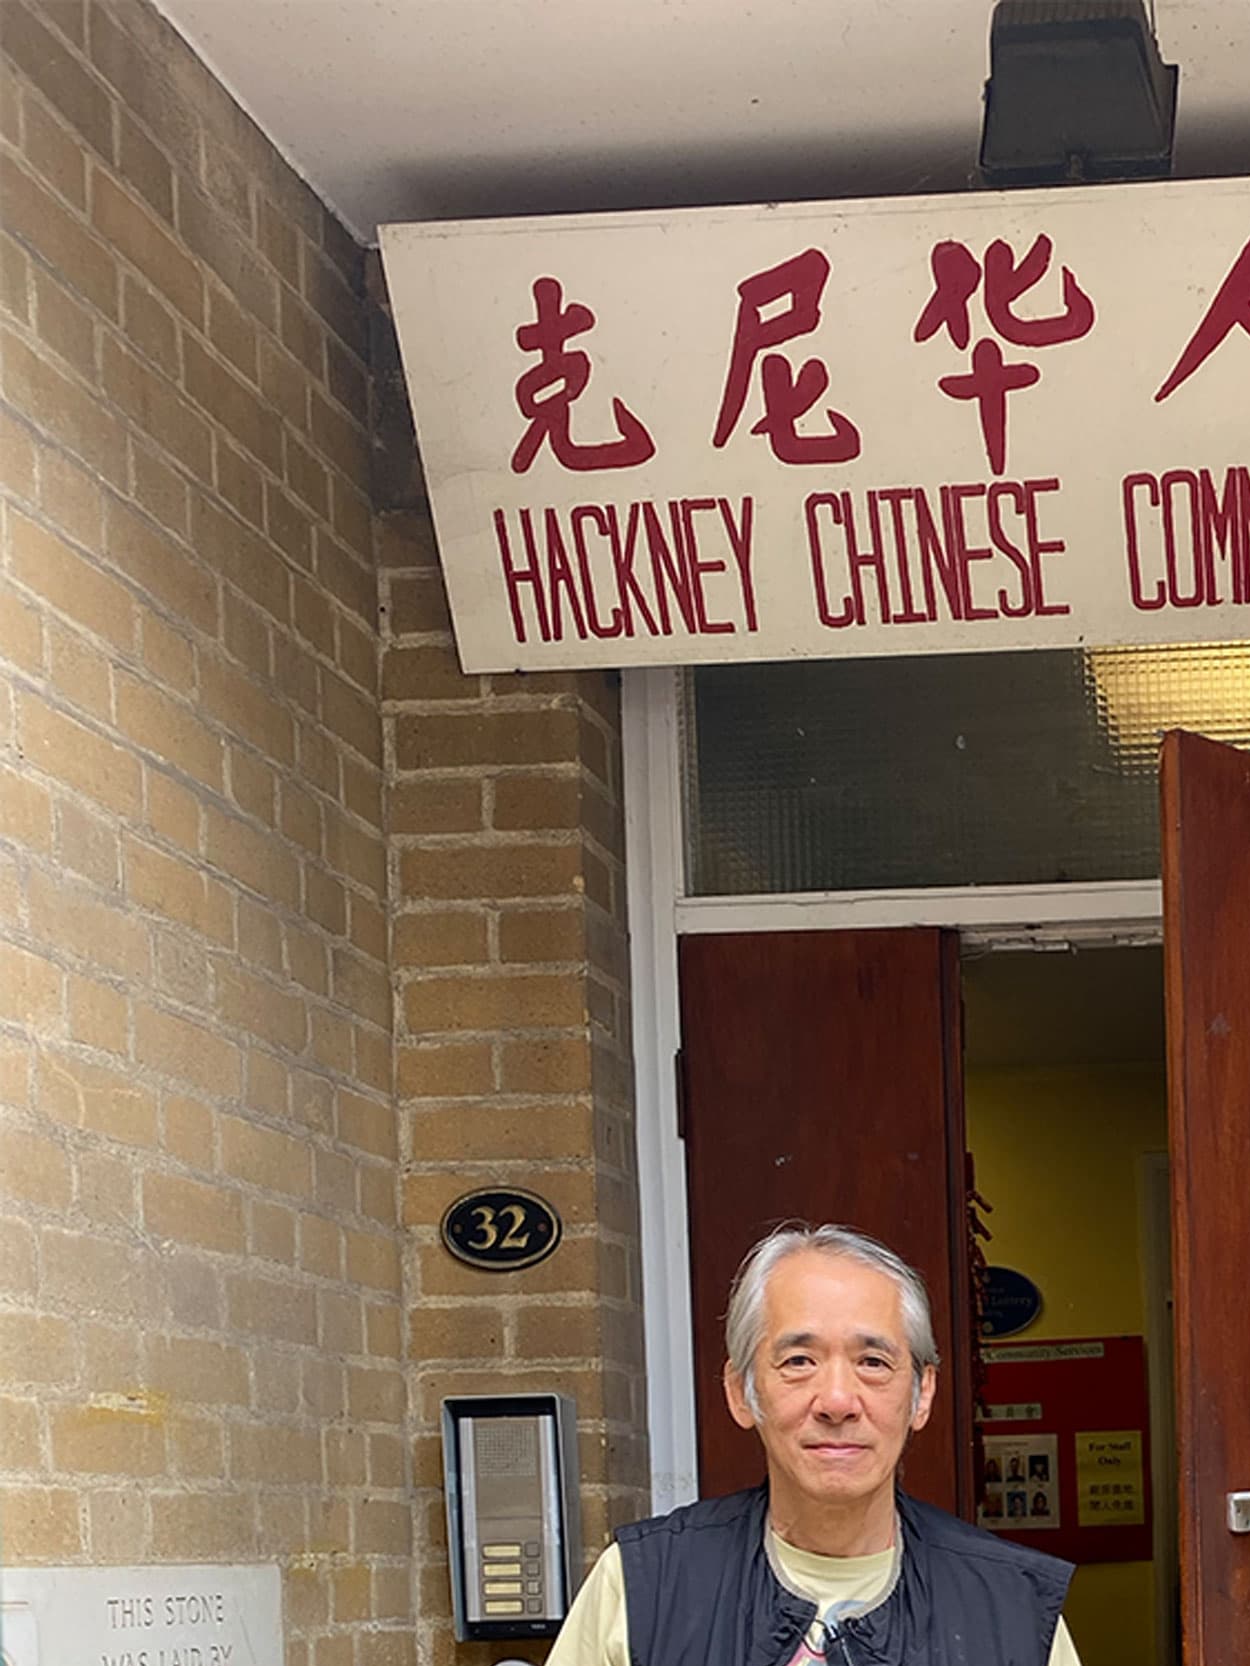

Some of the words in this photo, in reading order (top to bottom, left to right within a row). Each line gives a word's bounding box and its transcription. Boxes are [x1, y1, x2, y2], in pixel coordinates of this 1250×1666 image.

[495, 496, 759, 643] HACKNEY
[805, 477, 1070, 629] CHINESE
[468, 1204, 531, 1251] 32
[107, 1598, 154, 1629] THIS
[165, 1594, 224, 1625] STONE
